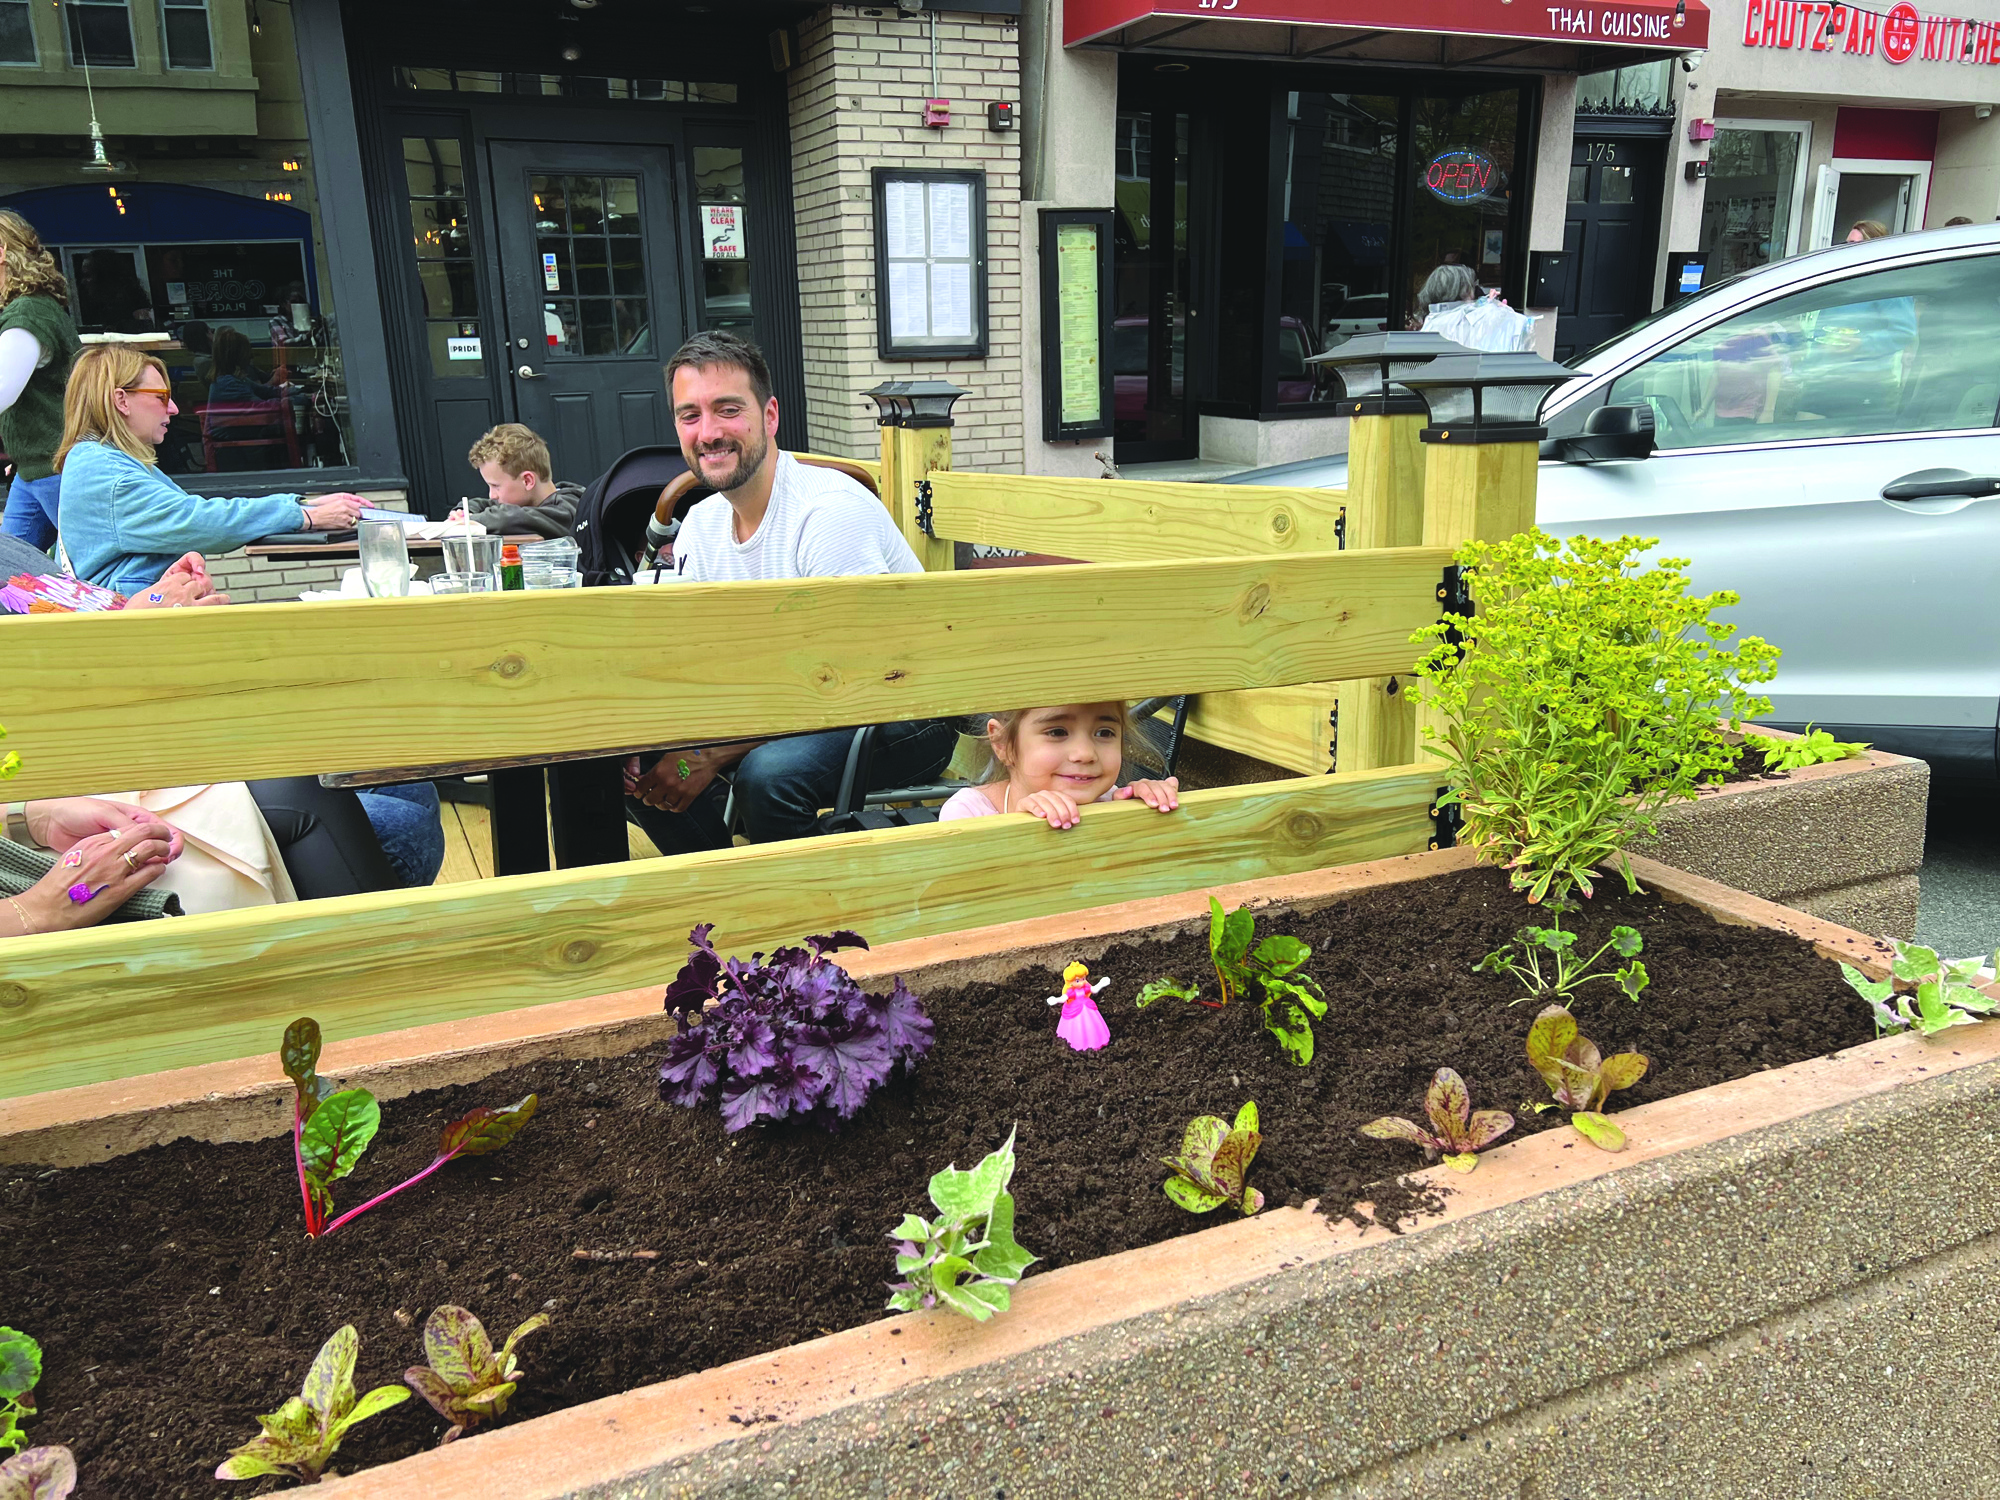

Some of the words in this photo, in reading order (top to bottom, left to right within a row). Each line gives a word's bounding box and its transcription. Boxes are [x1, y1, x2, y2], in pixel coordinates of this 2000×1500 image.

[1546, 7, 1593, 34] THAI
[1601, 11, 1671, 39] CUISINE
[1742, 0, 1878, 56] CHUTZPAH
[1586, 143, 1616, 162] 175
[1427, 163, 1492, 188] OPEN
